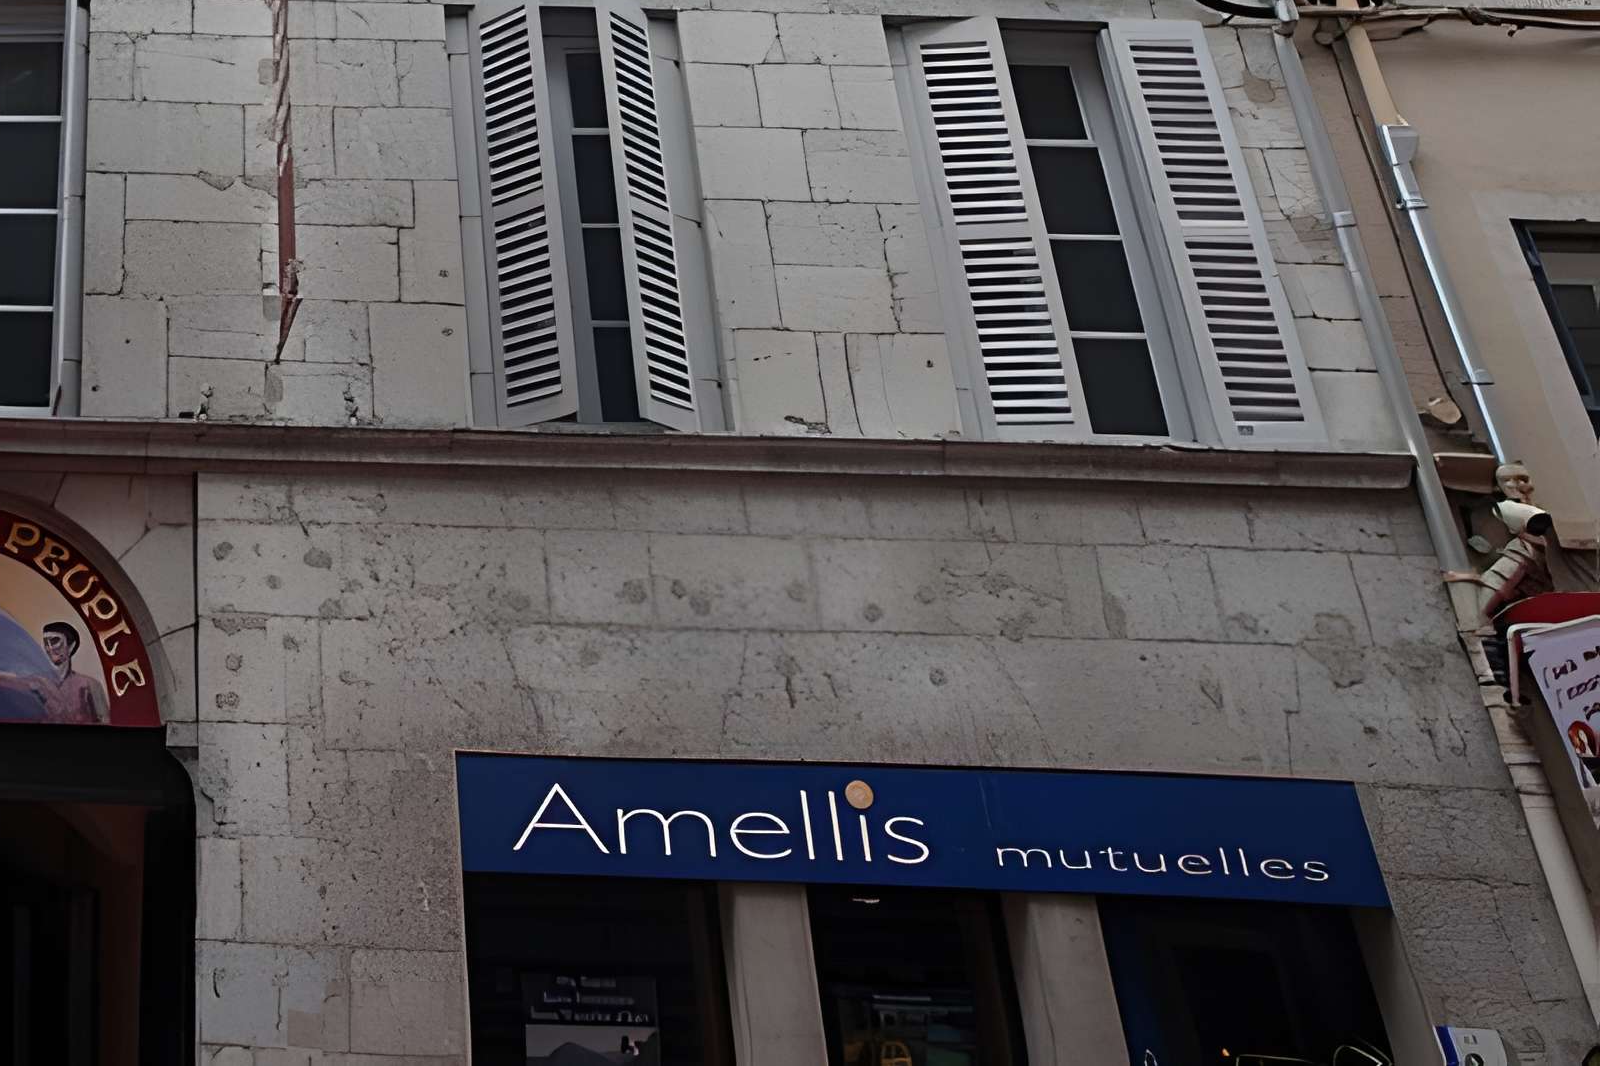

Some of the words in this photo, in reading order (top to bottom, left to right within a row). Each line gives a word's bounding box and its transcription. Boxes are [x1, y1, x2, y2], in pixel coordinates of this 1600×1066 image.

[4, 521, 146, 697] PEUPLE
[512, 779, 930, 864] Amellis
[996, 846, 1330, 883] mutuelles
